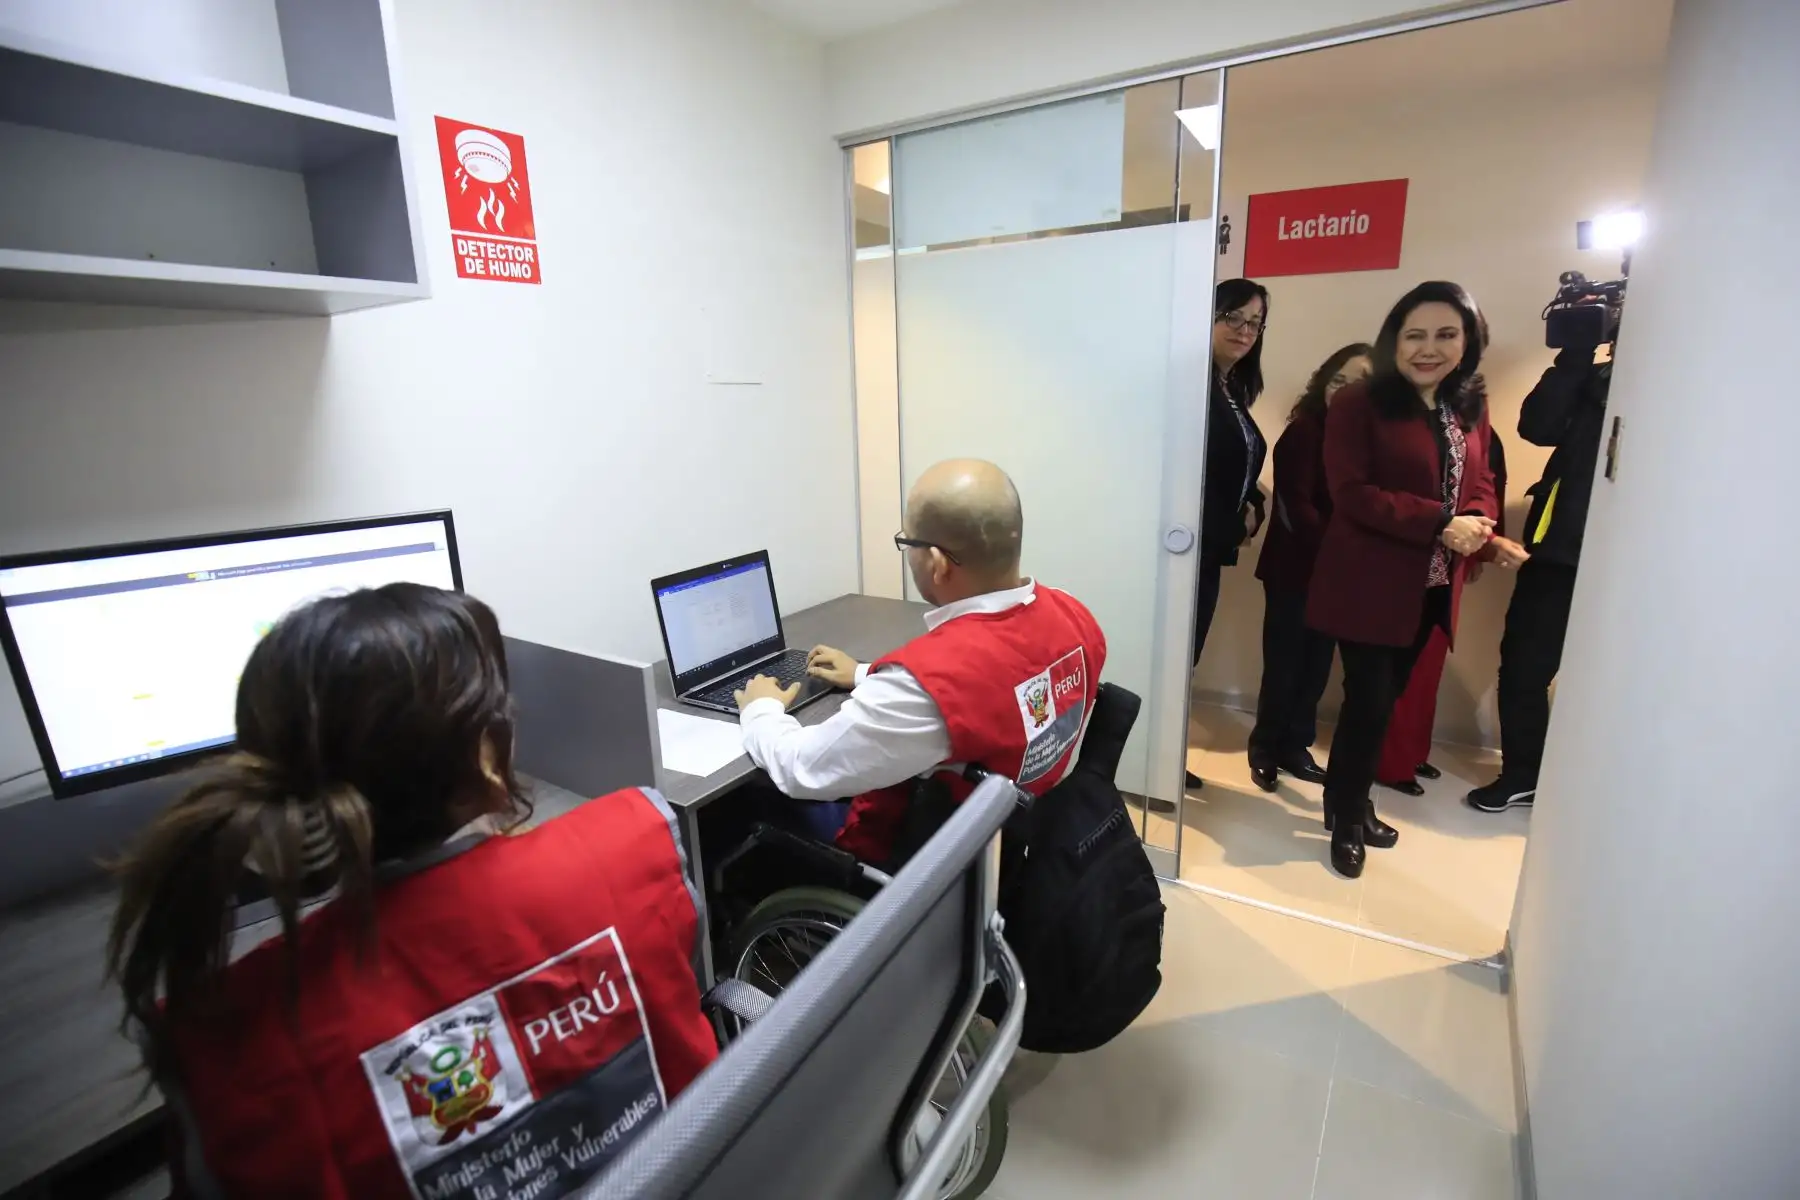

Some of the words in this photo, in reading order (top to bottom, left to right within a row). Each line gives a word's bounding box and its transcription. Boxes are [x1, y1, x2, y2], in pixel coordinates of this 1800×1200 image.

[1278, 209, 1371, 241] Lactario
[457, 238, 535, 263] DETECTOR
[464, 257, 486, 276] DE
[488, 261, 532, 279] HUMO
[1054, 667, 1082, 699] PERÚ
[524, 970, 621, 1056] PERÚ
[502, 1136, 561, 1187] Mujer
[571, 1121, 585, 1142] y
[561, 1091, 659, 1170] Vulnerables
[423, 1129, 532, 1200] Ministerio
